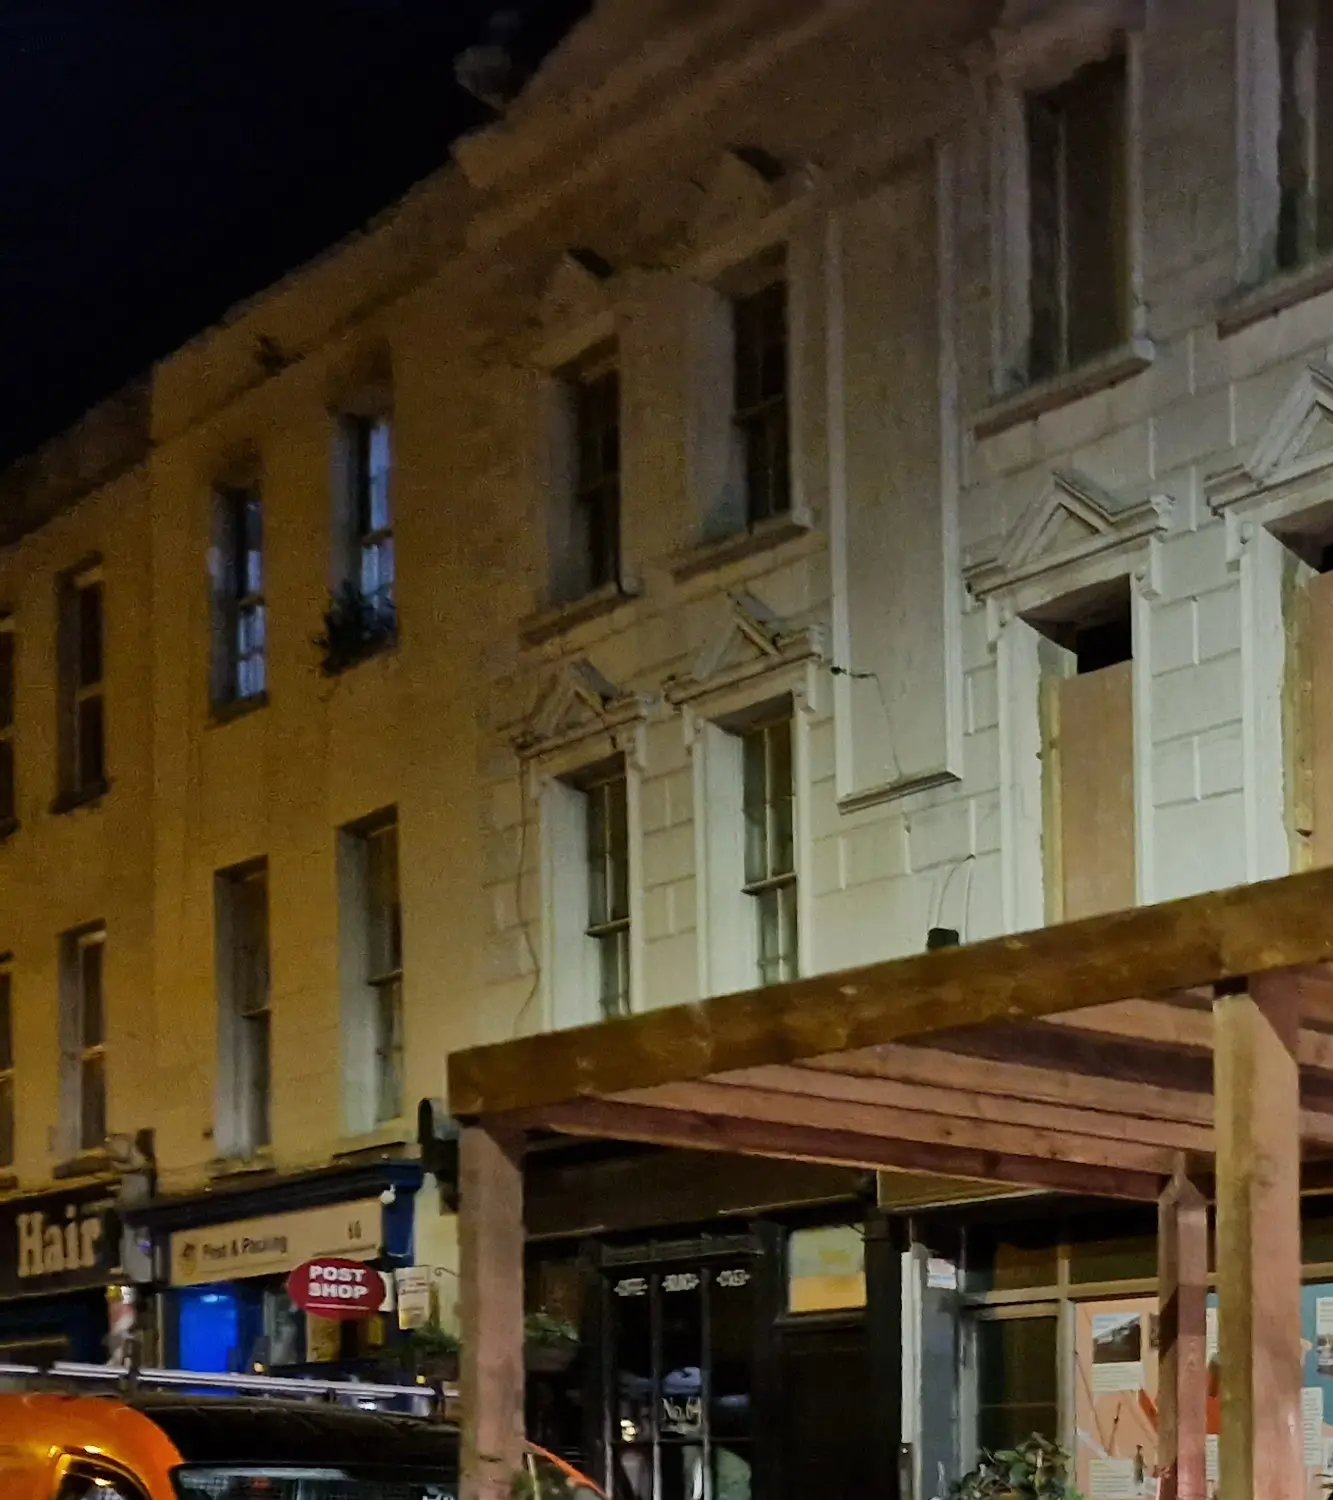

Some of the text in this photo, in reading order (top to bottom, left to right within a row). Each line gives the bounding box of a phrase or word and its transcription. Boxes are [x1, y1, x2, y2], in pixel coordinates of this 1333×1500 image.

[16, 1204, 102, 1278] Hair
[309, 1265, 367, 1282] POST
[308, 1283, 369, 1300] SHOP
